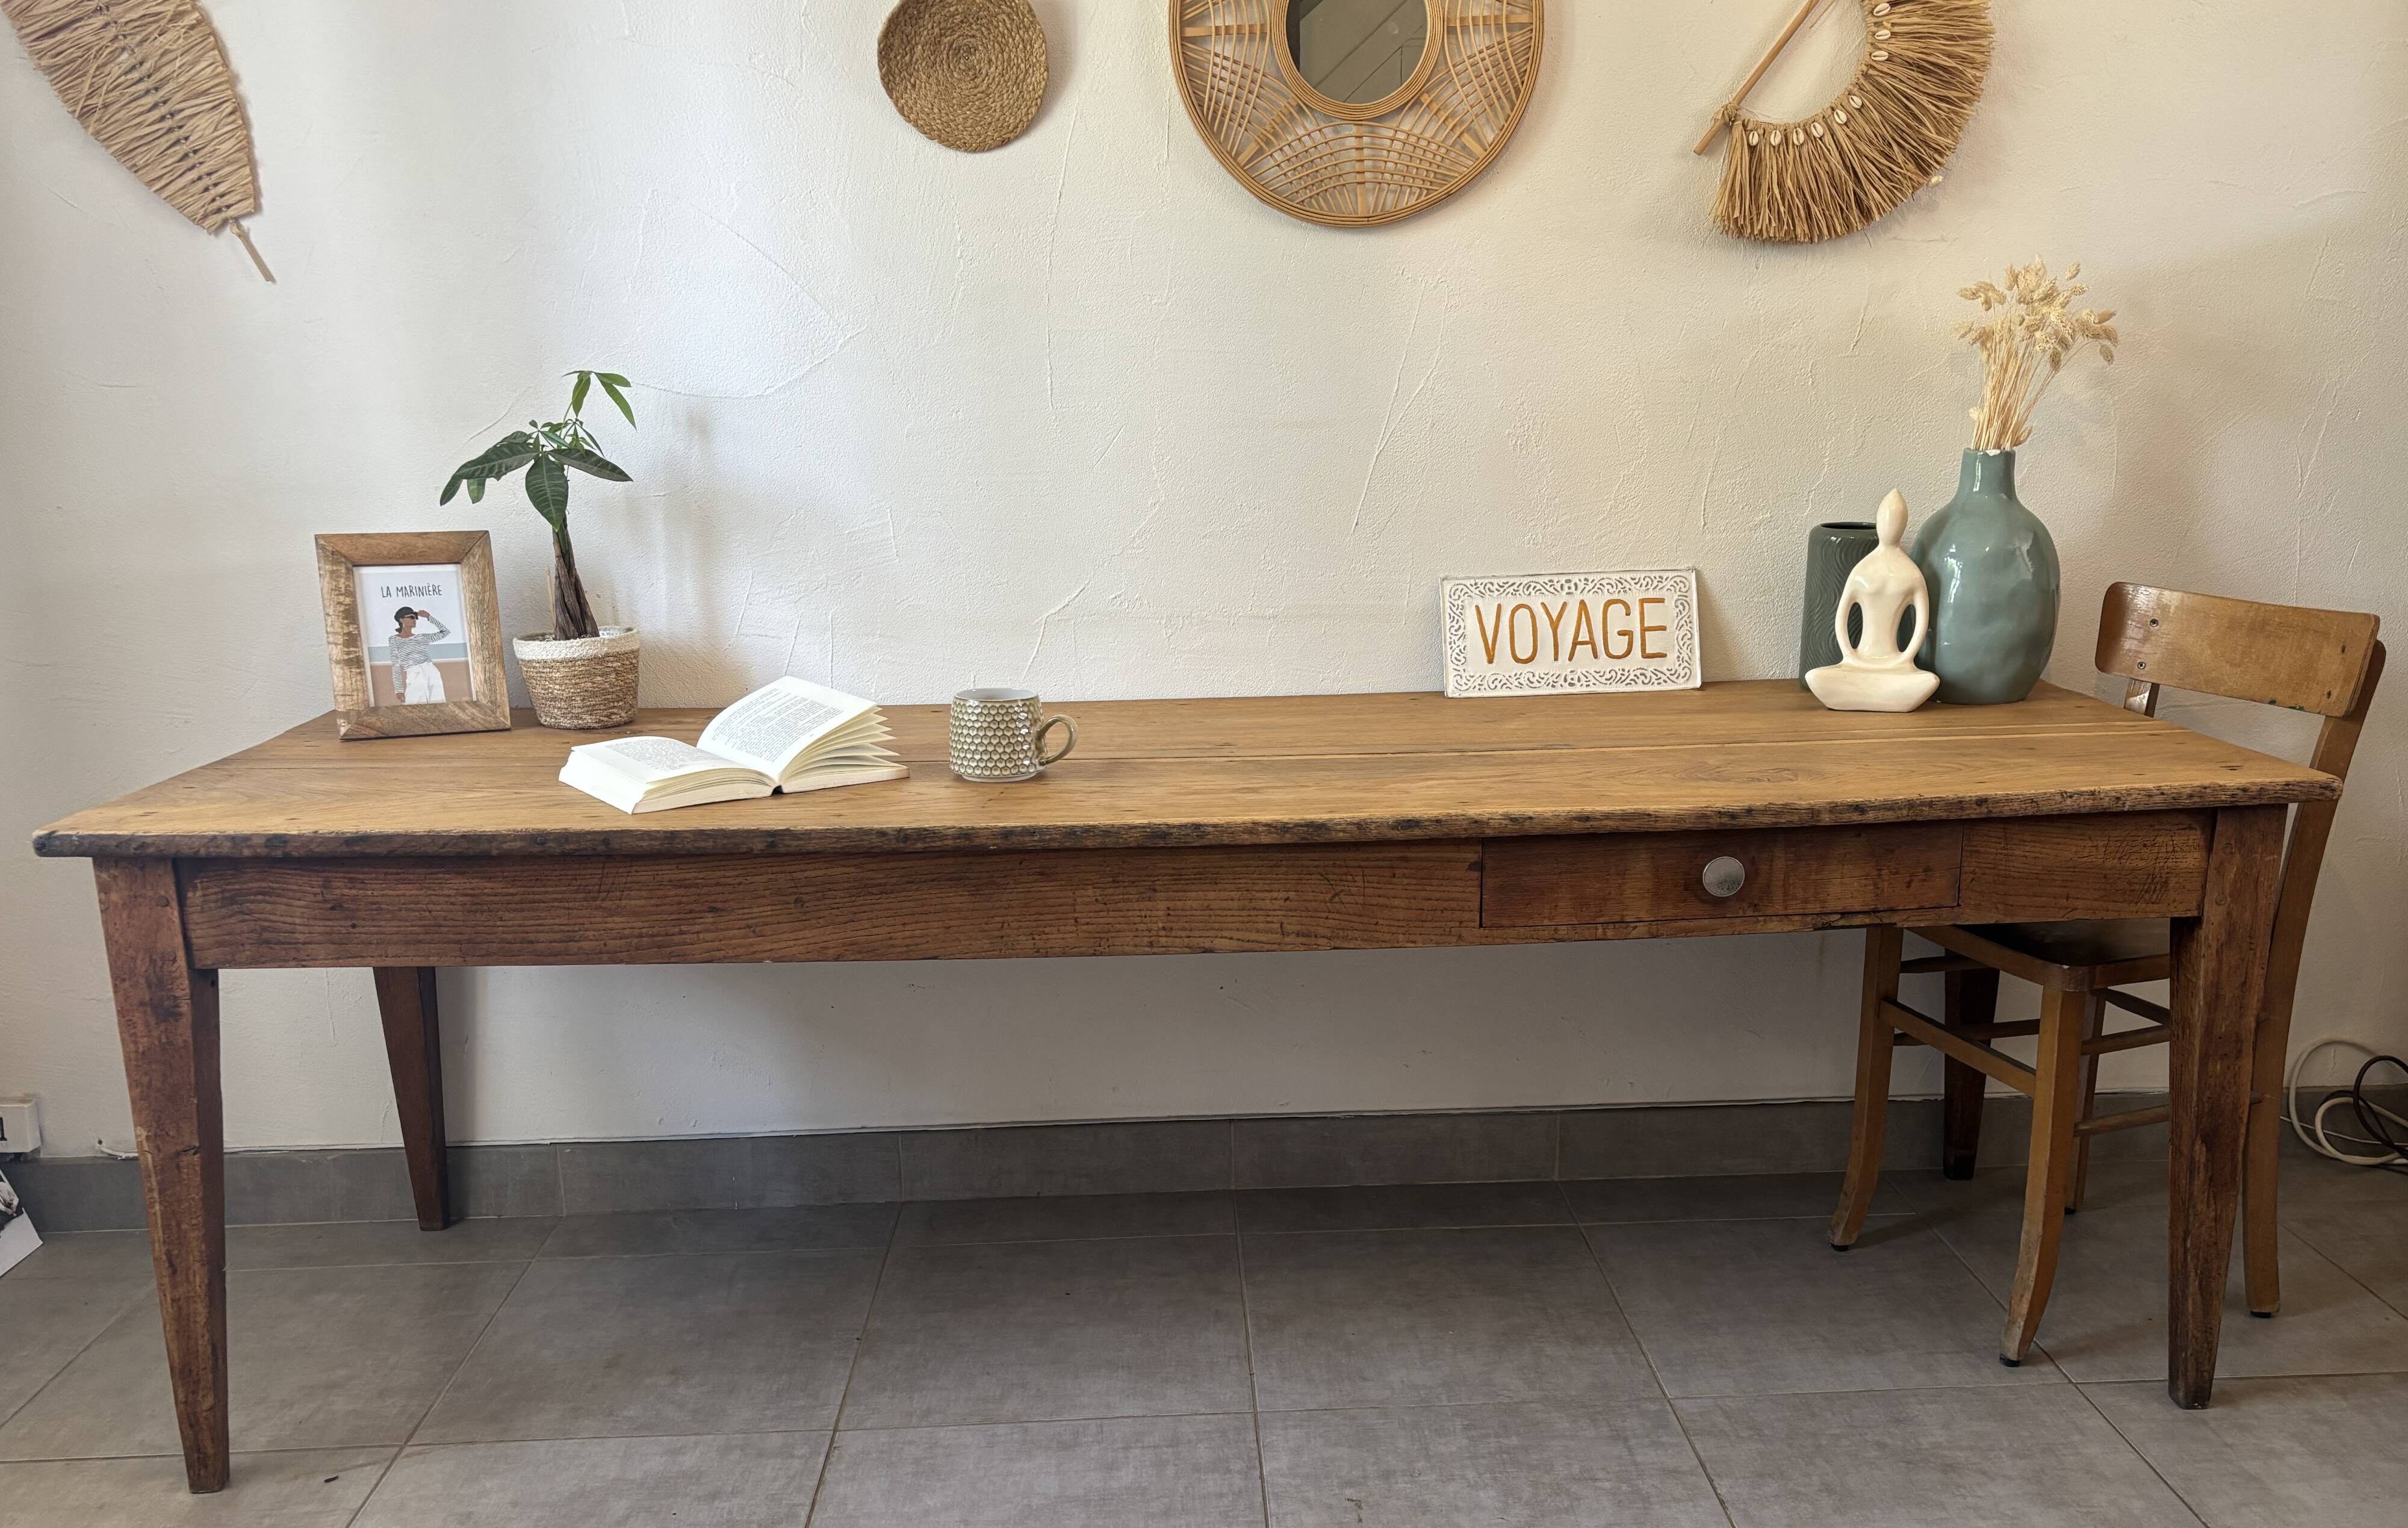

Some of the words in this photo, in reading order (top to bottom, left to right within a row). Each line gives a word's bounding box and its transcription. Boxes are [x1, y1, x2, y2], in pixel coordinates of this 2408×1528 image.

[380, 586, 392, 598] LA
[396, 583, 442, 598] MARINIÈRE
[1474, 597, 1668, 665] VOYAGE
